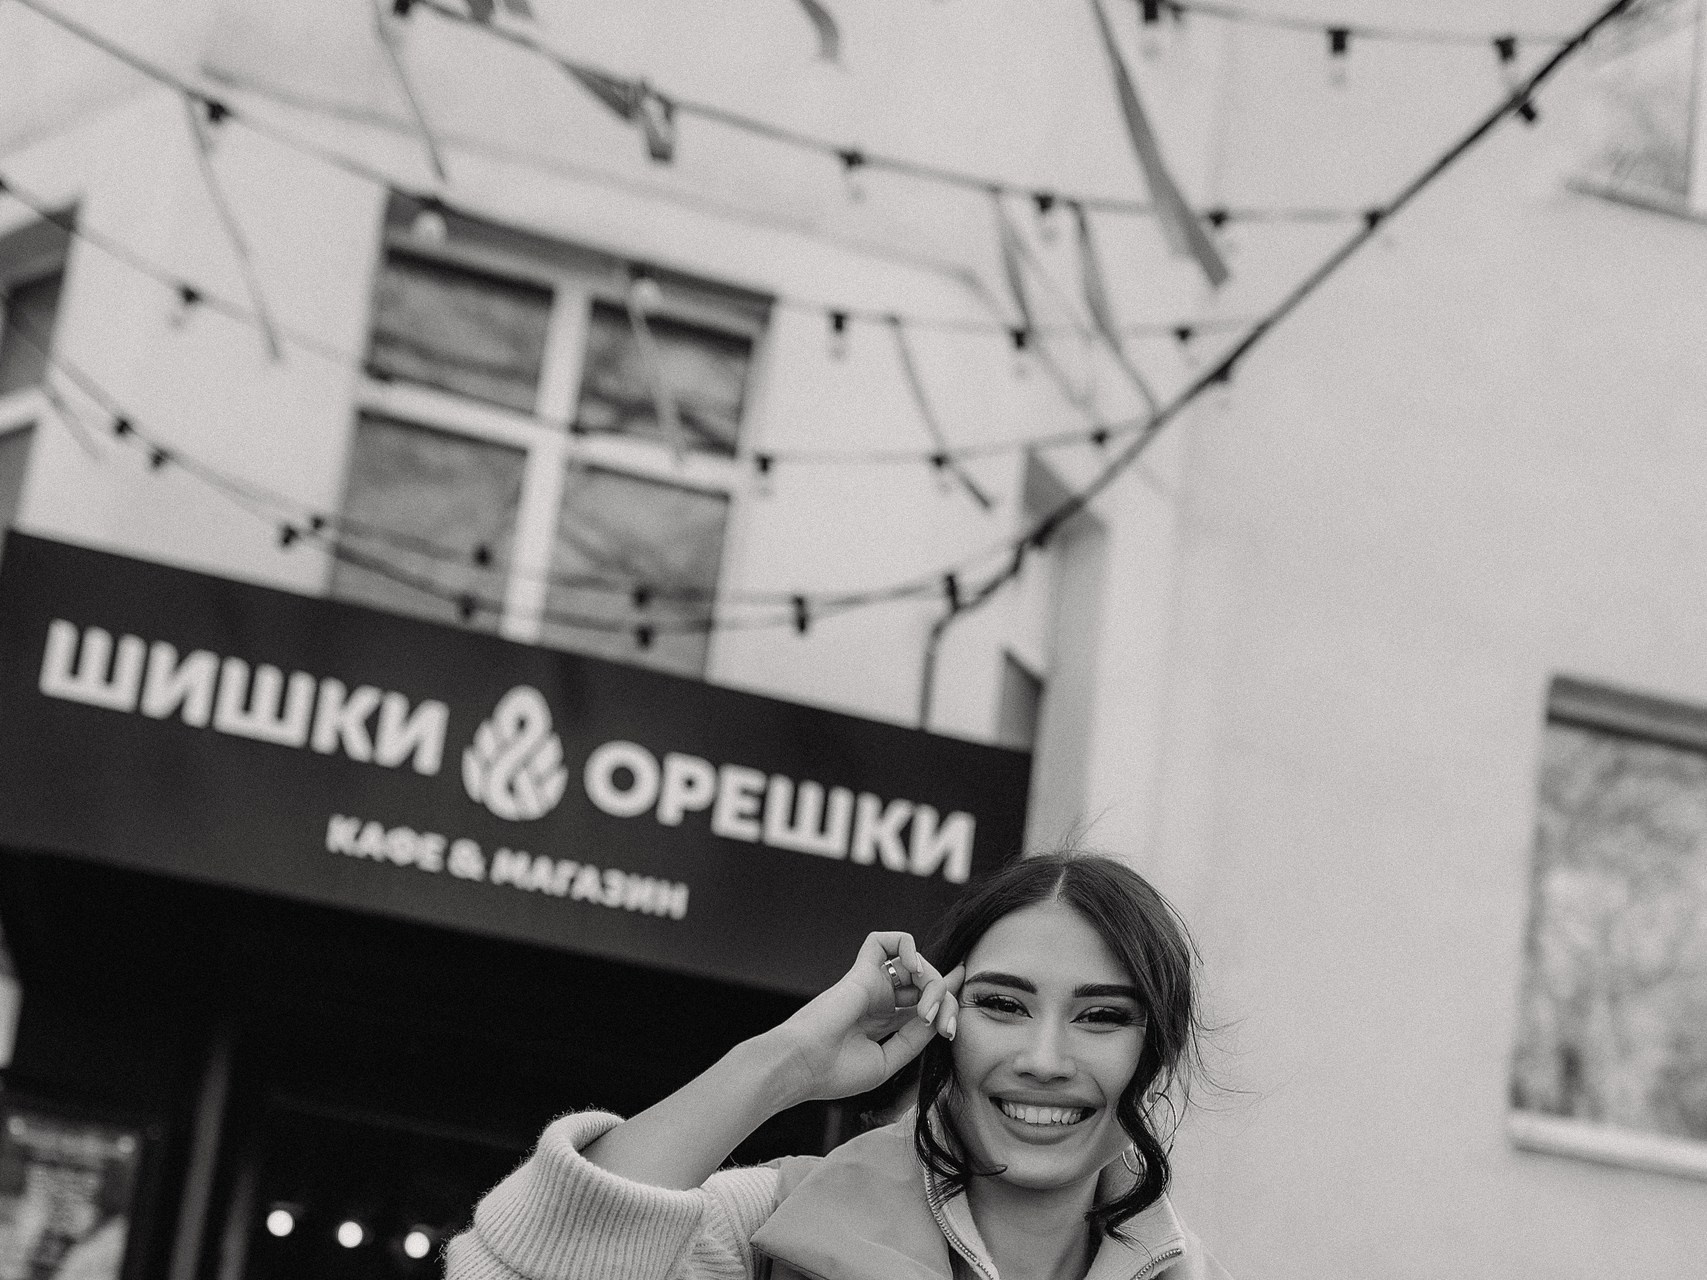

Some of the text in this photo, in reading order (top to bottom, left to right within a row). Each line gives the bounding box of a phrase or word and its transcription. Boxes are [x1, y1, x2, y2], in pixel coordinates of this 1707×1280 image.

[39, 619, 976, 884] ШИШКИ ОРЕШКИ
[326, 814, 689, 919] КАФЕ & МАГАЗИН
